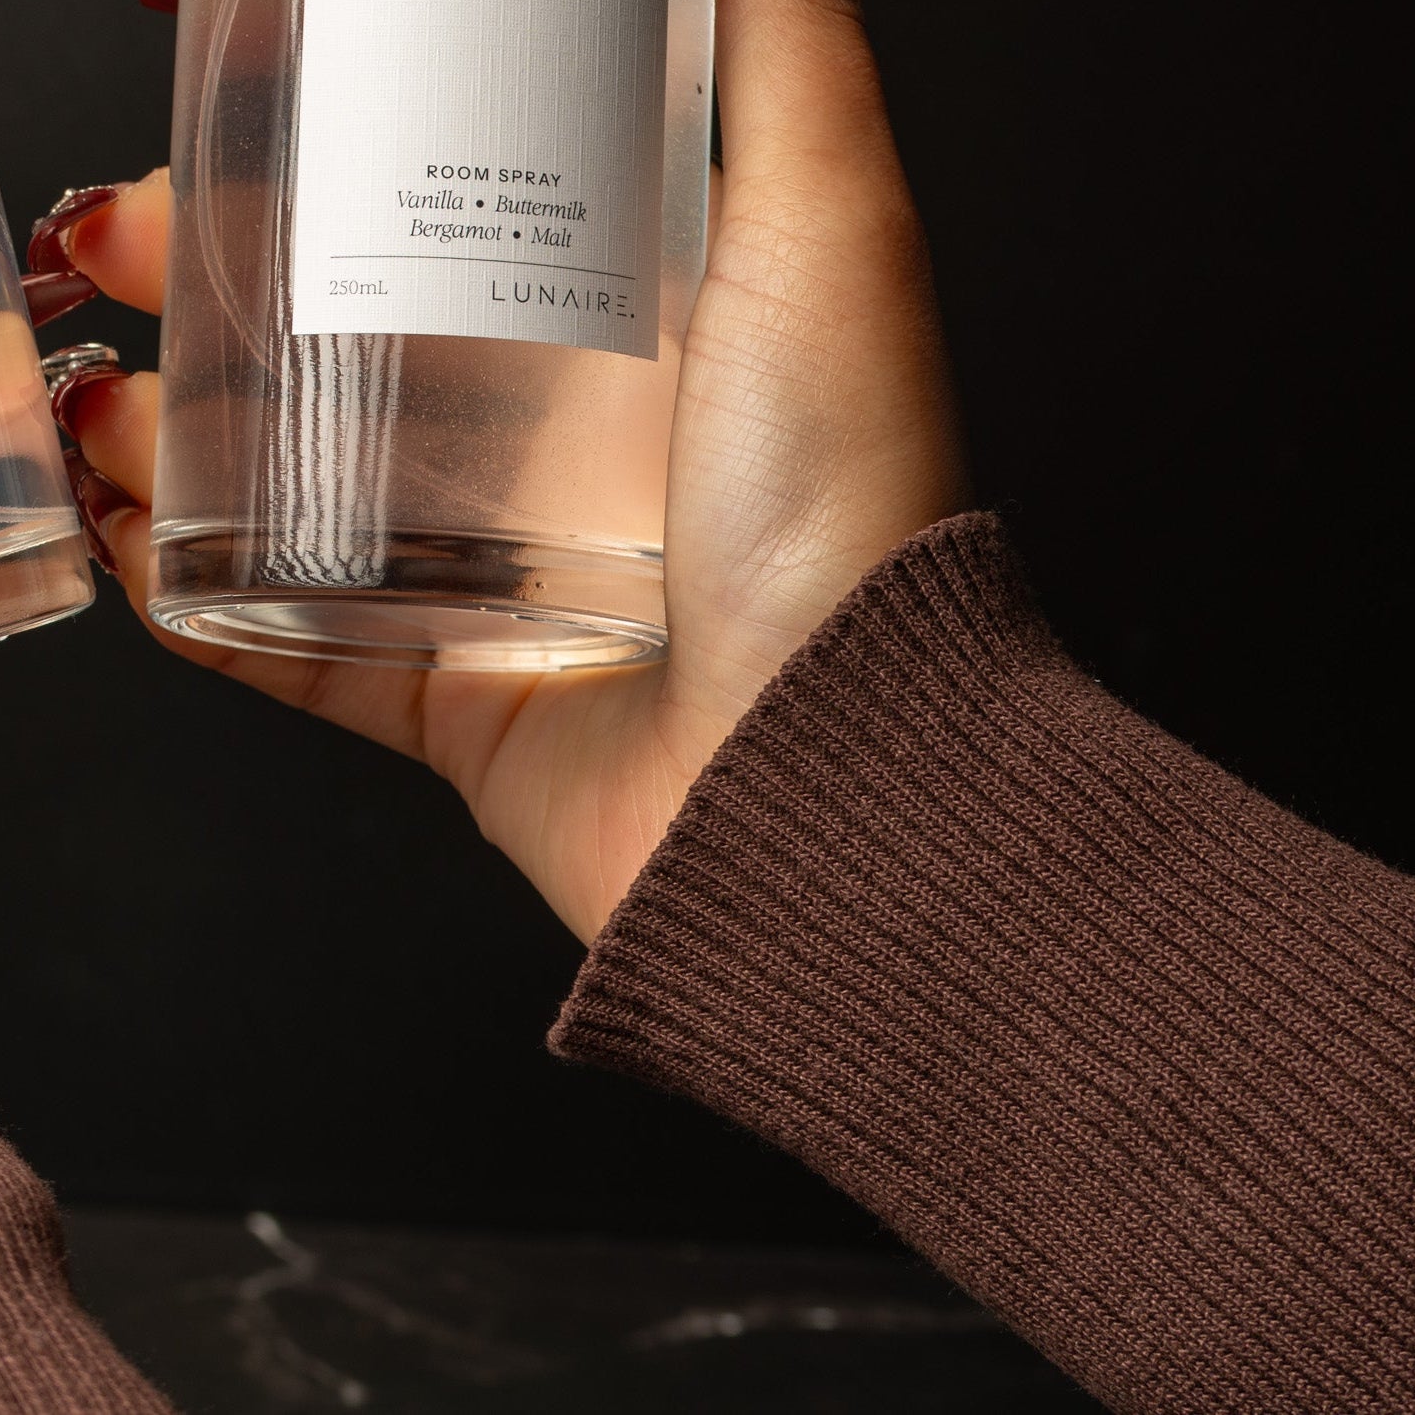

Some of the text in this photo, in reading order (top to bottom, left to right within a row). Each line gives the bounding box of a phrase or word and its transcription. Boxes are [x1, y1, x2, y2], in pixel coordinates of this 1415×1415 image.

[426, 164, 562, 187] ROOM SPRAY
[397, 190, 587, 222] Vanilla Buttermilk
[410, 219, 572, 248] Bergamot Malt
[329, 279, 389, 296] 250mL
